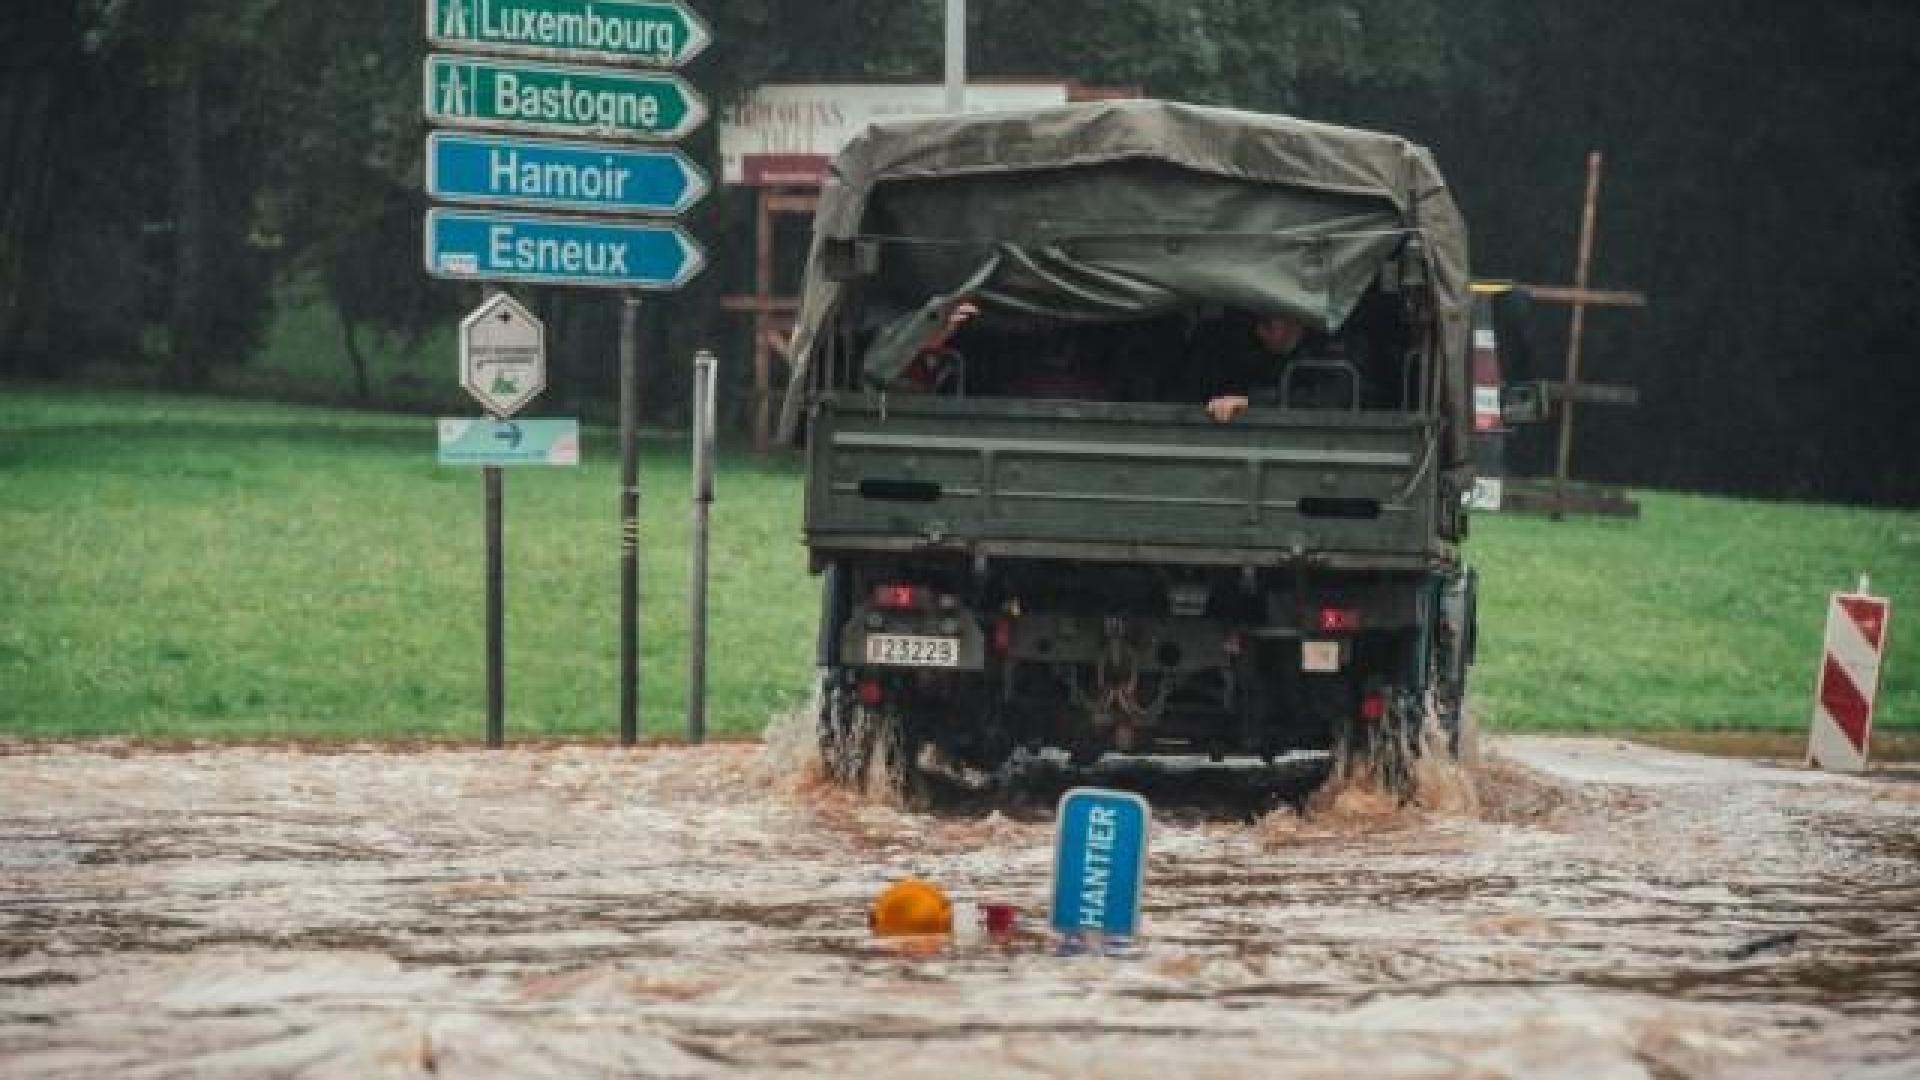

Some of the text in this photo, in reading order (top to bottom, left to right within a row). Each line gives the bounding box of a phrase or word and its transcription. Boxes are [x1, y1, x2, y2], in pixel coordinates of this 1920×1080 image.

[482, 0, 674, 57] Luxembourg
[495, 74, 658, 134] Bastogne
[489, 149, 630, 199] Hamoir
[489, 227, 628, 275] Esneux
[1080, 806, 1118, 928] HANTIER
